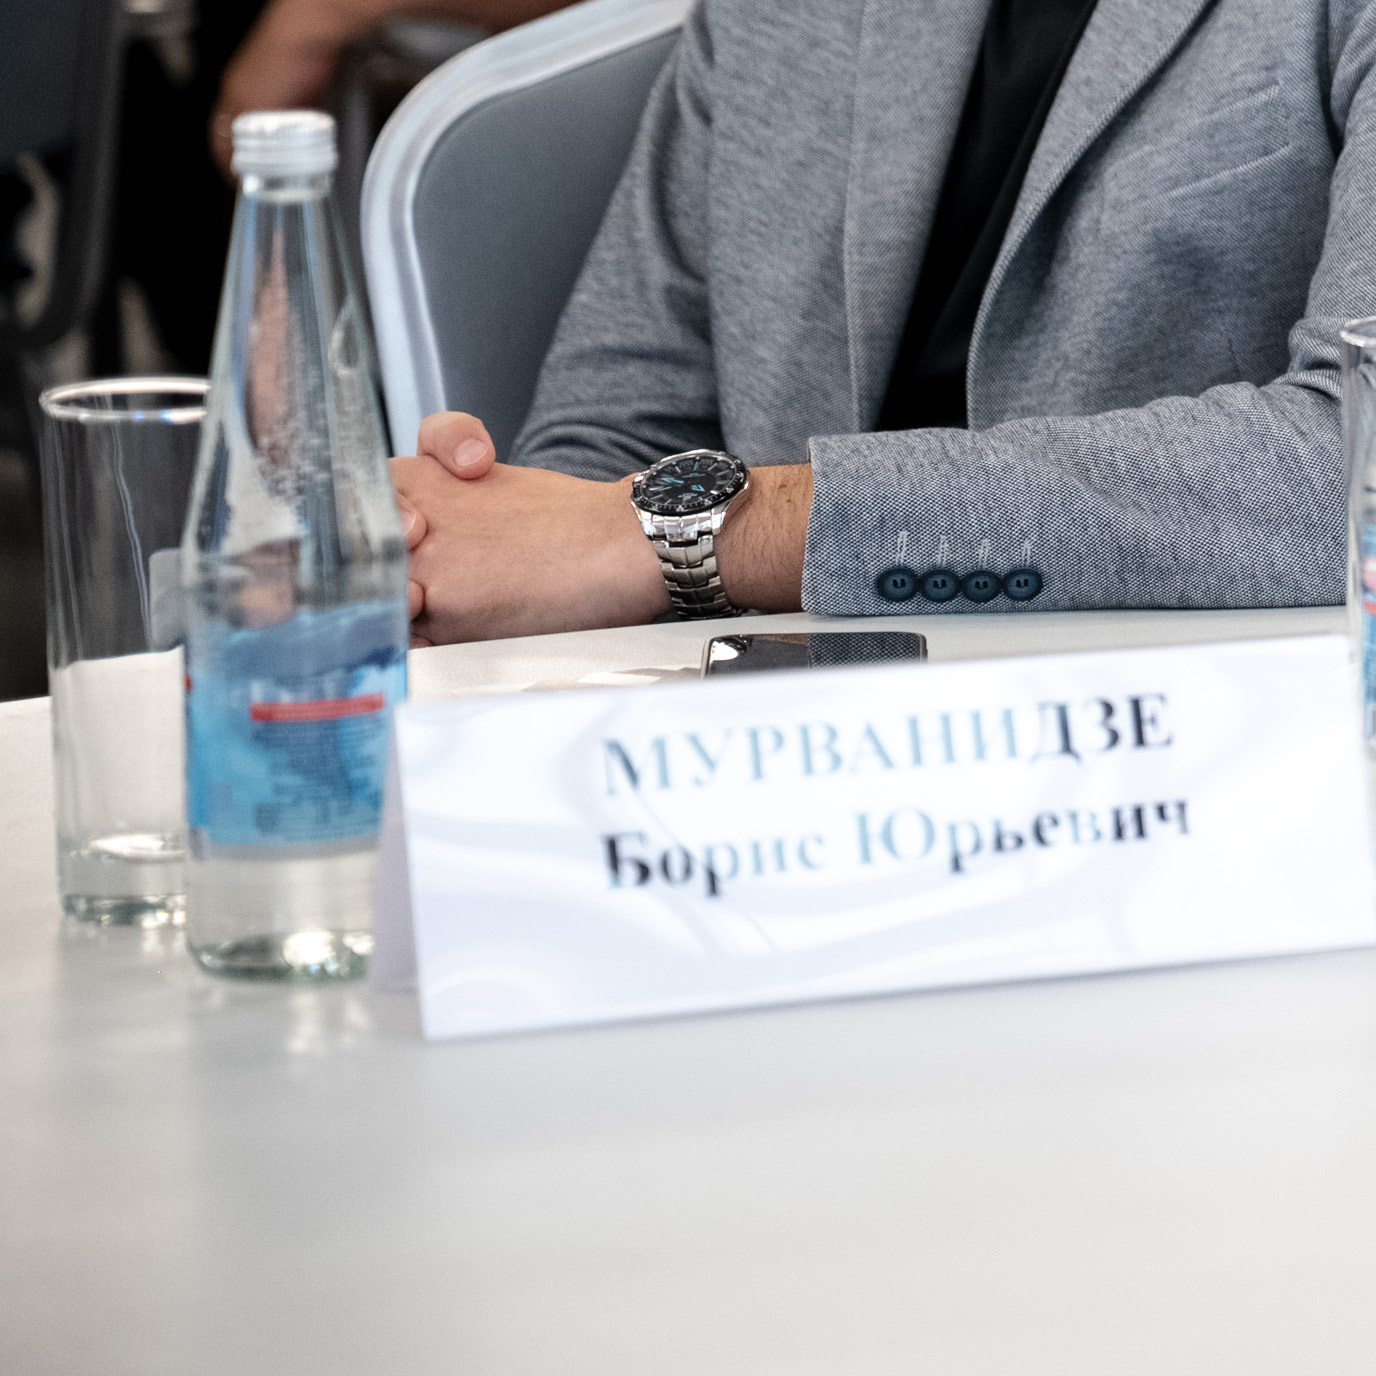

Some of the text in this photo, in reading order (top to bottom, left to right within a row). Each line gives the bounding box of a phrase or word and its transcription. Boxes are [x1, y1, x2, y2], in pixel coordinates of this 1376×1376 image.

[602, 692, 1176, 798] МУРВАНИДЗЕ
[602, 796, 1192, 899] Борис Юрьевич
